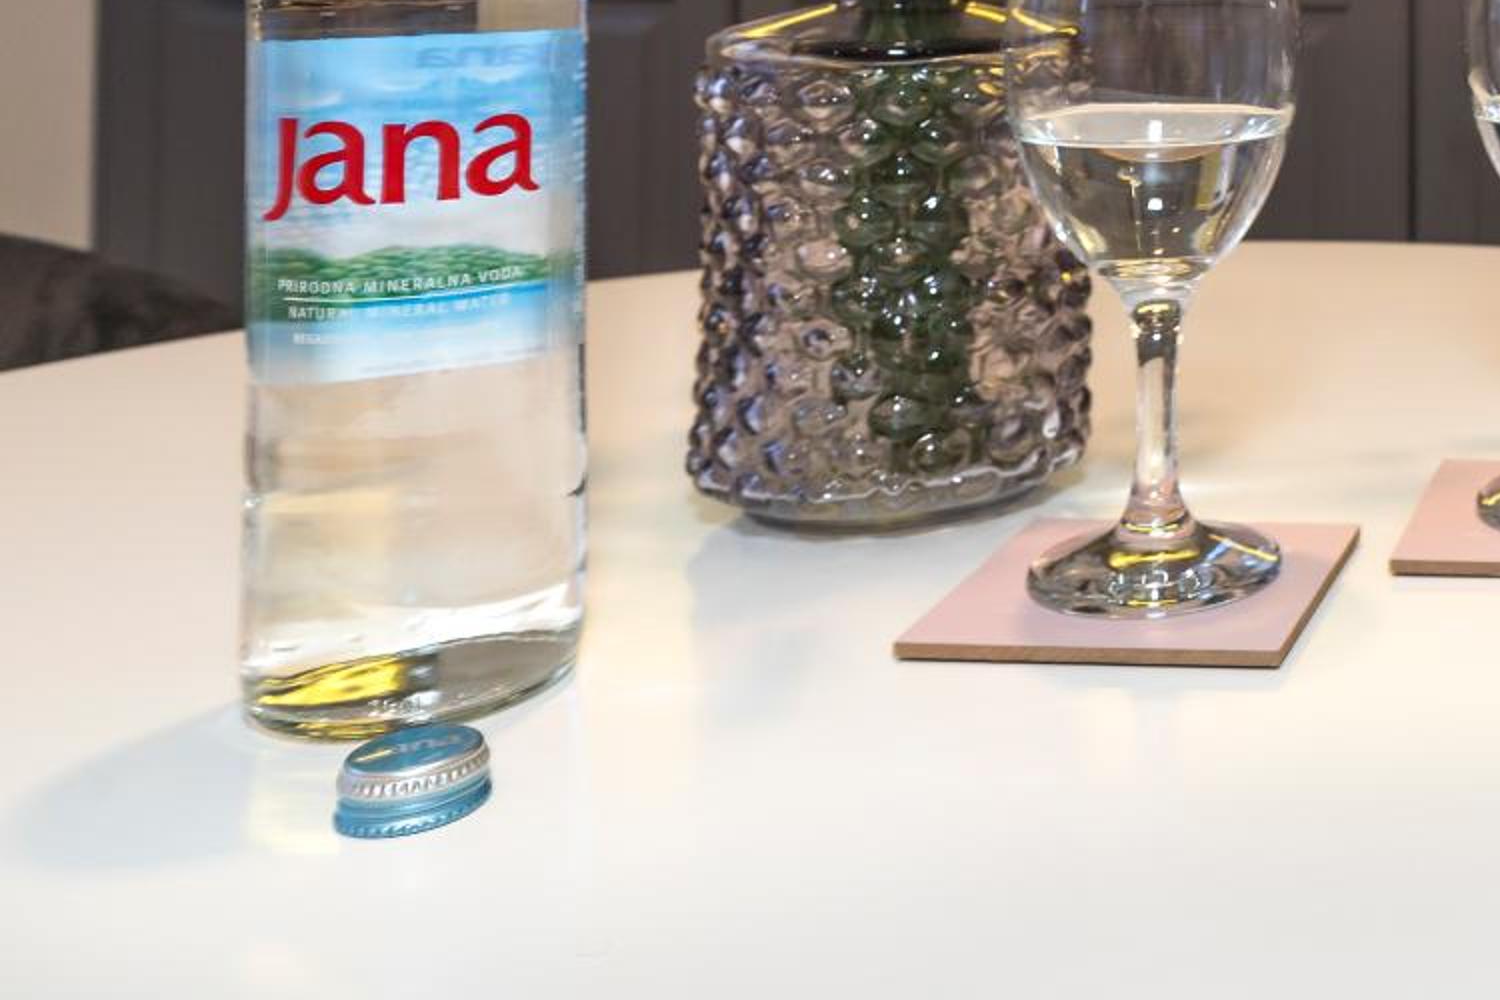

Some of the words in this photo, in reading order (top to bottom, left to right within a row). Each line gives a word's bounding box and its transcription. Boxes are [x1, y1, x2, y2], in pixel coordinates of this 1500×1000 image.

[277, 278, 354, 296] PRIRODNA
[363, 272, 472, 294] MINERALNA
[478, 264, 524, 284] VODA
[287, 305, 352, 321] NATUR
